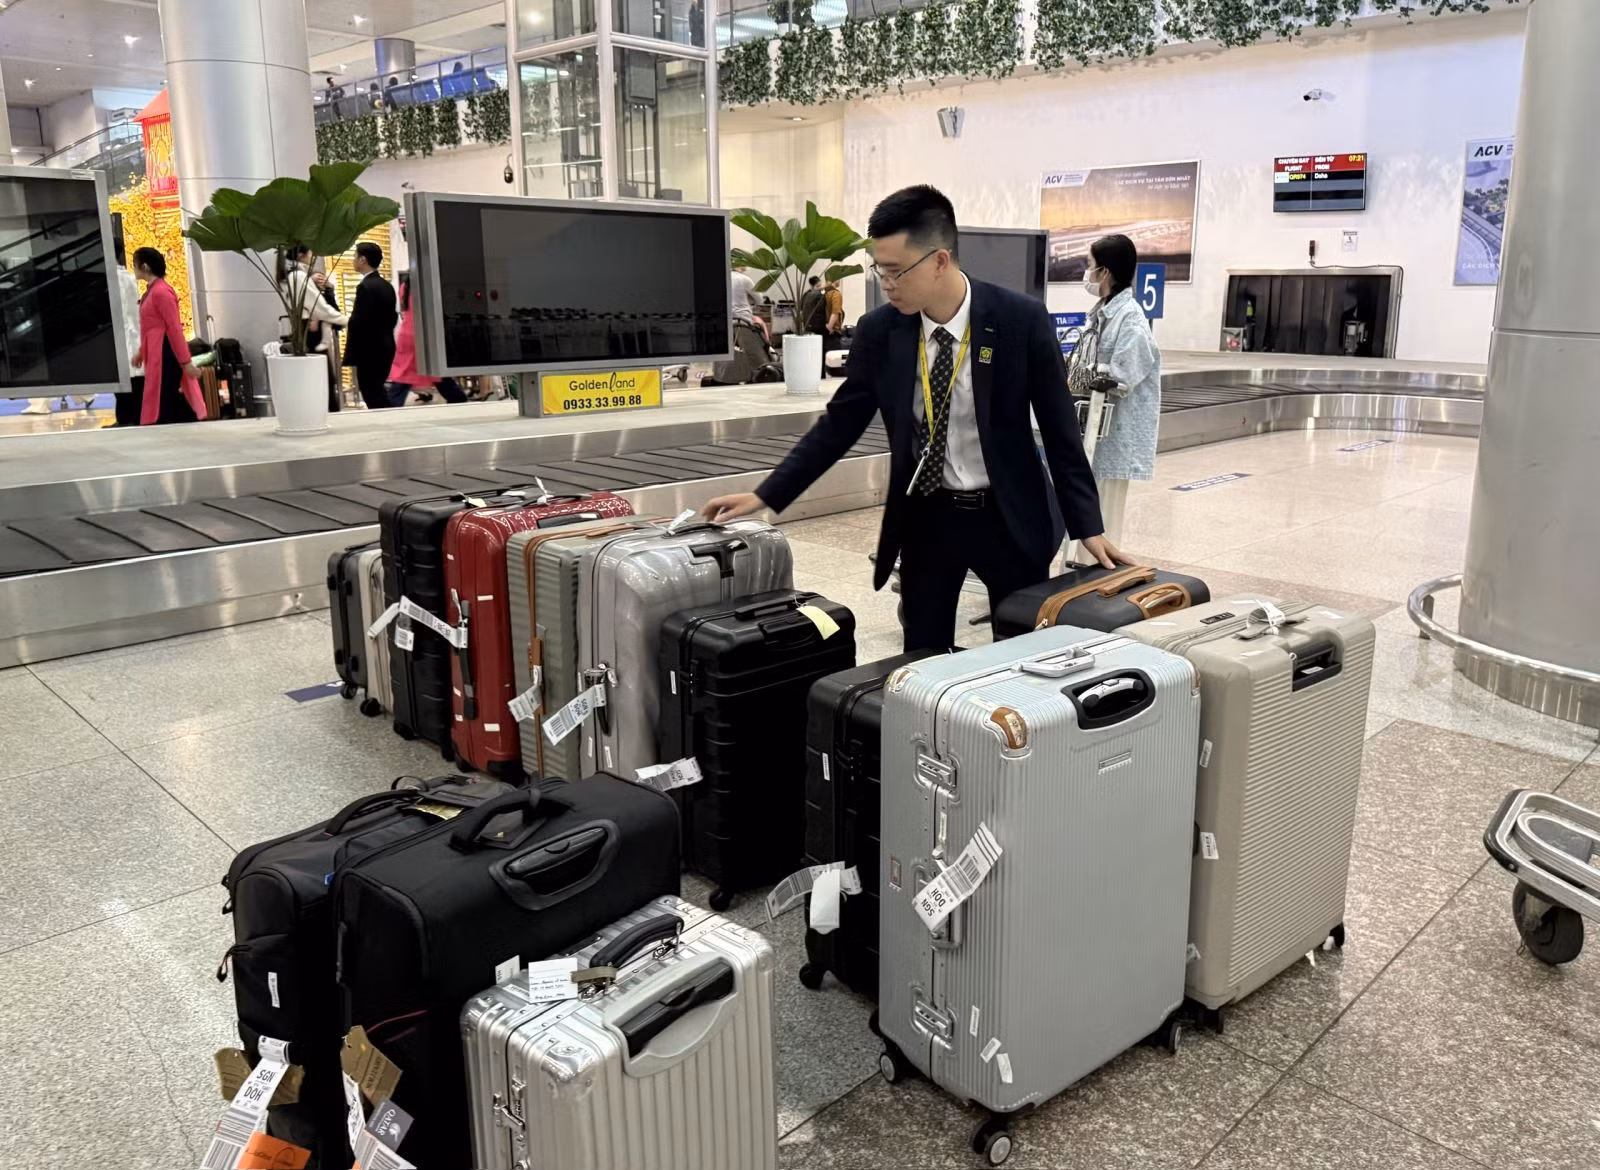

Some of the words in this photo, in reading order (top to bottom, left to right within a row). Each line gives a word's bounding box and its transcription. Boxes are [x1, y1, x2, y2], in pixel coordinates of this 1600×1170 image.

[1474, 144, 1504, 157] ACV
[1045, 175, 1063, 184] ACV
[1143, 273, 1157, 311] 5
[1056, 317, 1068, 325] TIA
[563, 395, 642, 410] 0933.33.99.88
[930, 888, 946, 907] DOH
[921, 898, 935, 917] SGN
[256, 1069, 276, 1082] SGN
[243, 1086, 263, 1101] DOH
[379, 1109, 396, 1136] QATAR
